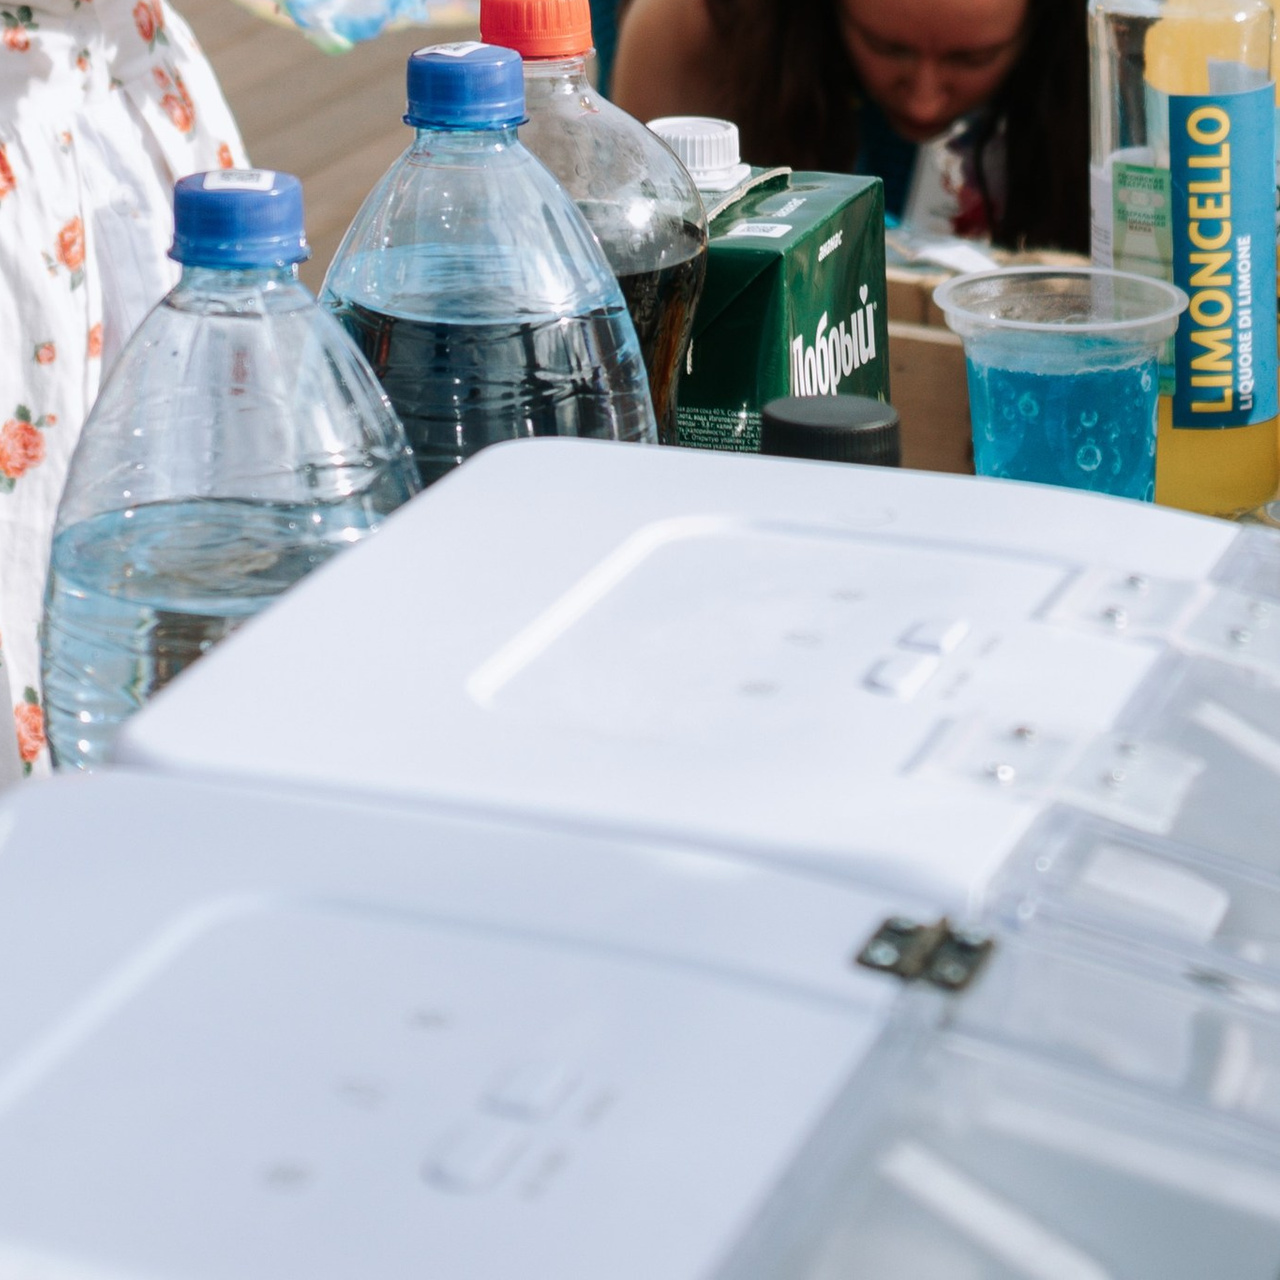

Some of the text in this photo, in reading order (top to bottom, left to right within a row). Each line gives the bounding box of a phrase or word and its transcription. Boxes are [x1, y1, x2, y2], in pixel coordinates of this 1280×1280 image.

[1186, 105, 1232, 413] LIMONCELLO
[1236, 234, 1254, 411] LIQUORE DI LIMONE
